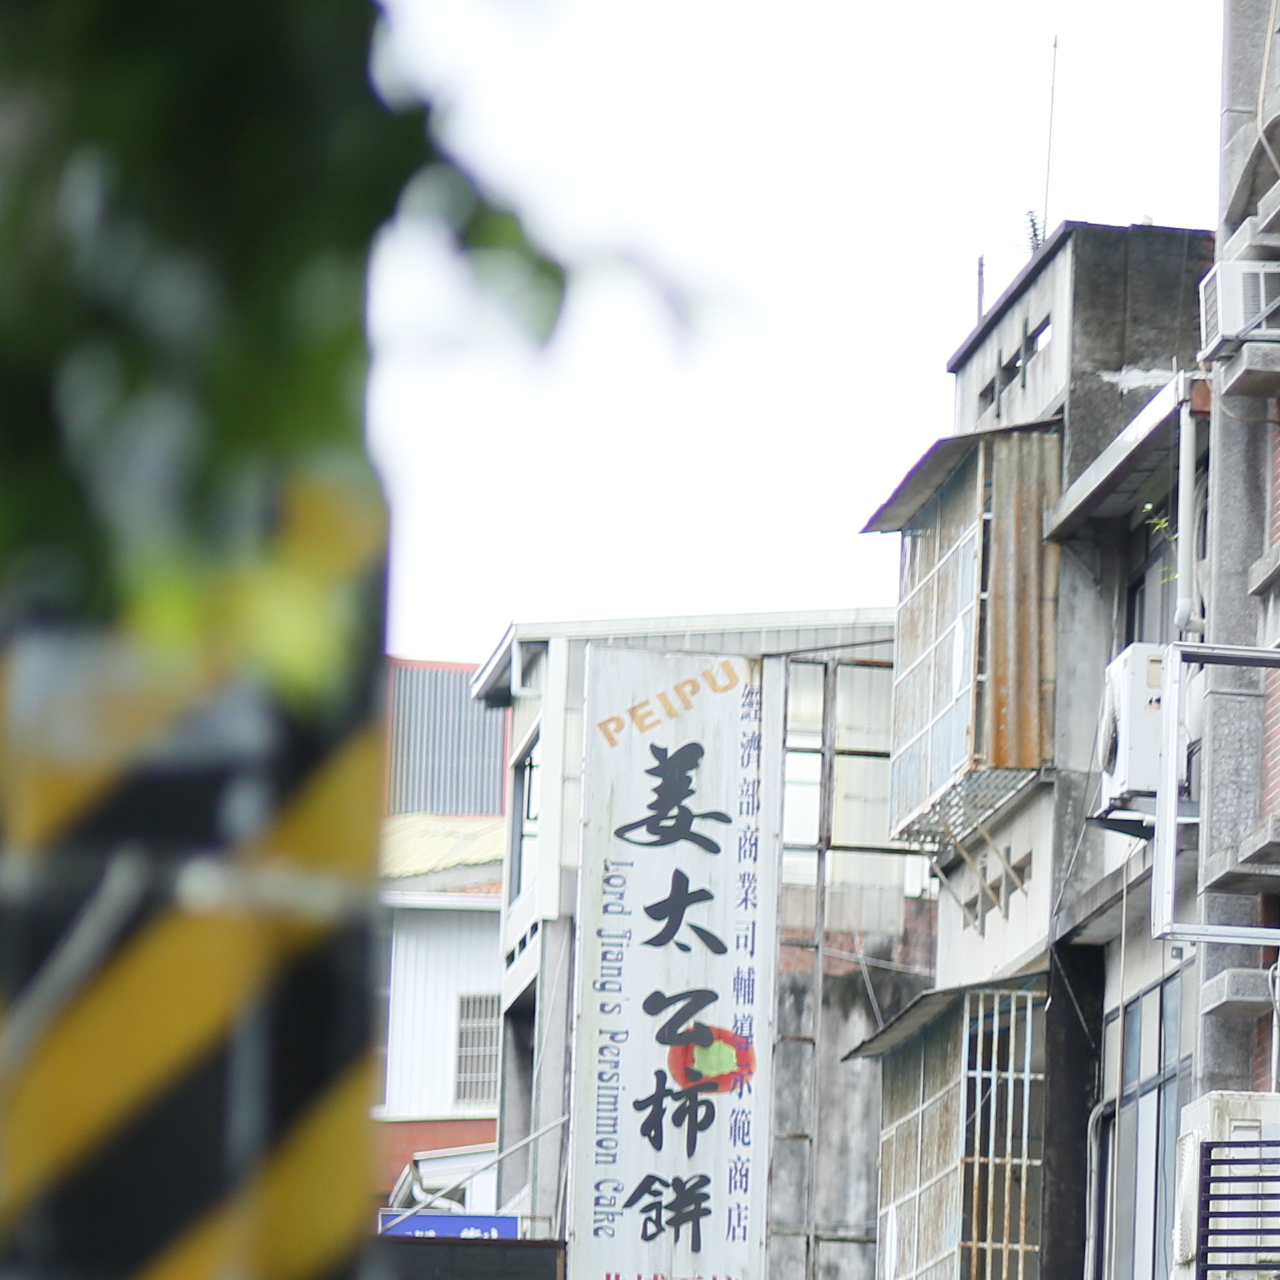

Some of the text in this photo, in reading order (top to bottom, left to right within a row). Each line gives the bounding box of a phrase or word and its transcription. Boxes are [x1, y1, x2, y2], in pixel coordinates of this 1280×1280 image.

[598, 660, 740, 747] PEIPU
[602, 857, 634, 915] Lord
[614, 742, 732, 1253] 姜太公柿餅
[595, 1028, 629, 1166] Persimmon
[592, 1178, 625, 1239] Cake
